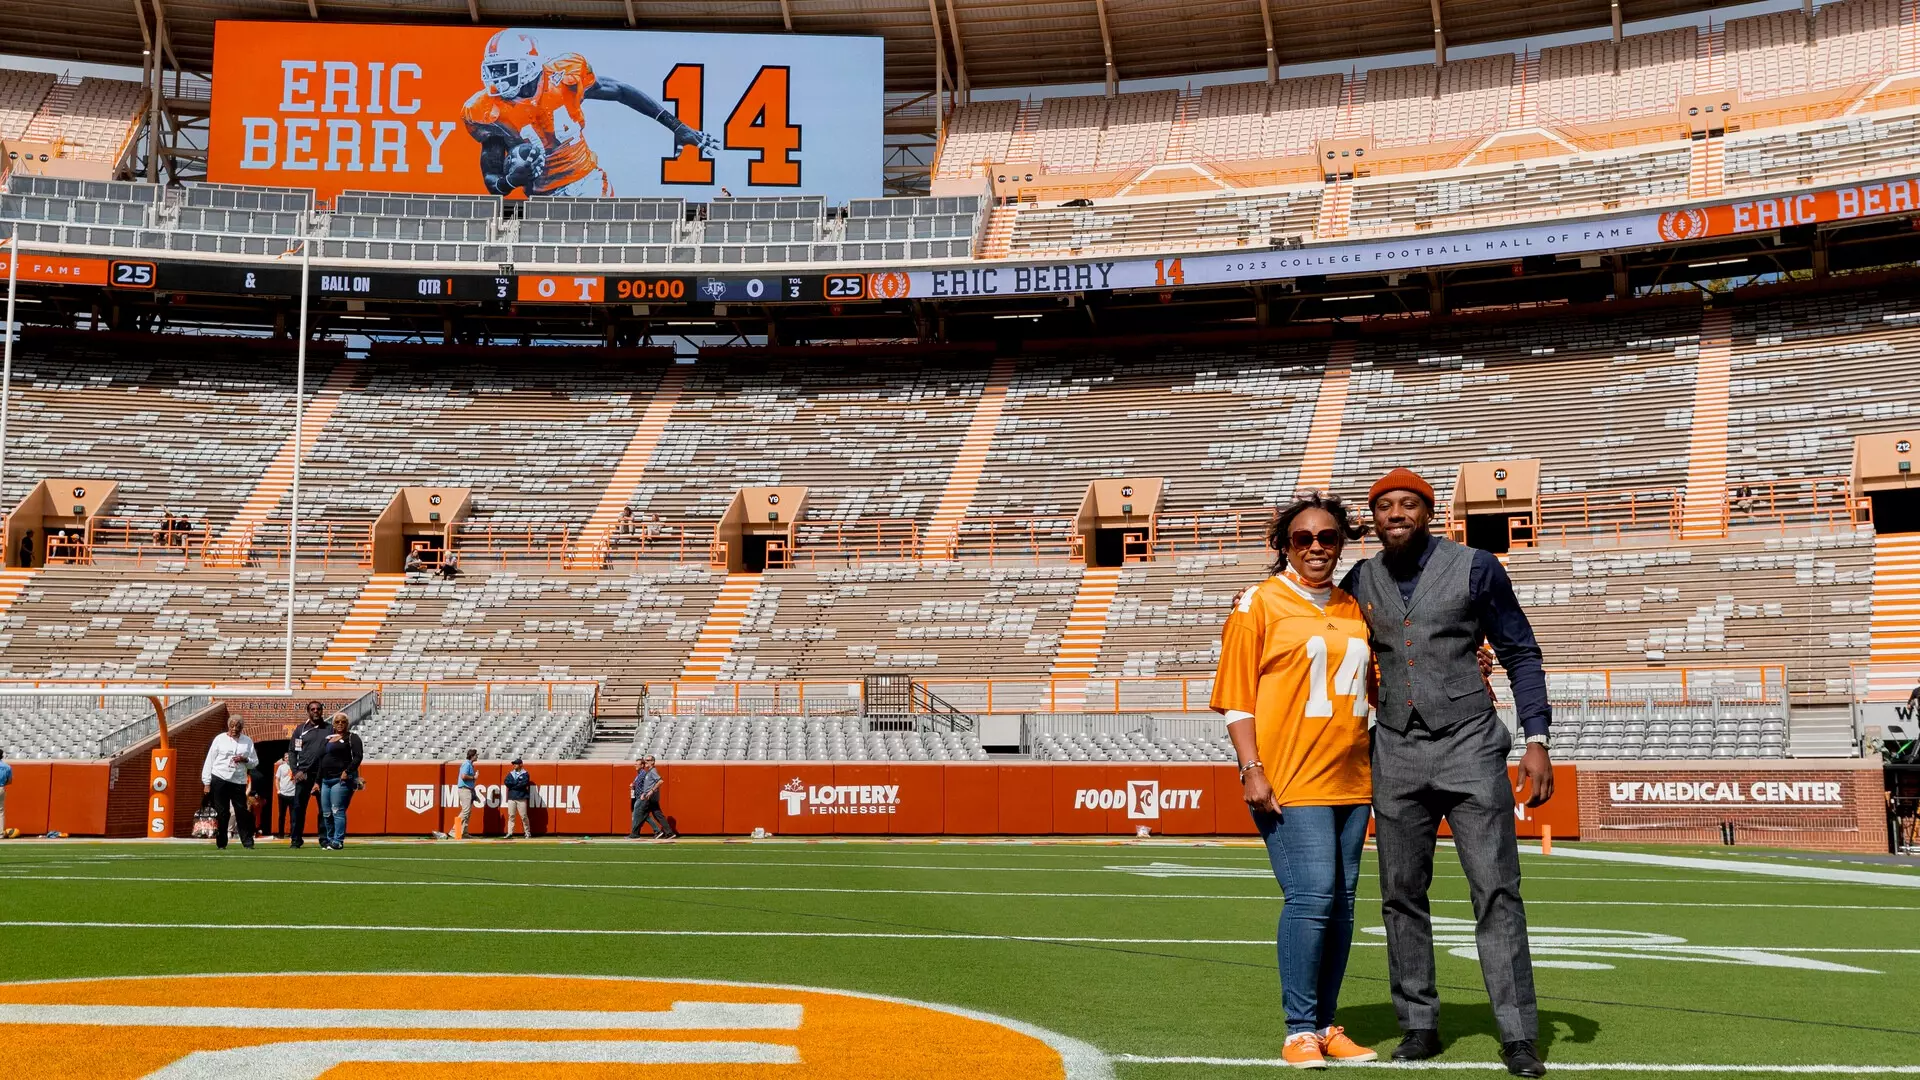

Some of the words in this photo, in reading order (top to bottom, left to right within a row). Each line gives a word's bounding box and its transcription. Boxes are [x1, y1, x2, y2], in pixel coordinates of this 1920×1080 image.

[279, 60, 423, 114] ERIC
[660, 63, 802, 187] 14
[239, 117, 456, 173] BERRY
[1731, 194, 1817, 233] ERIC
[1836, 178, 1920, 219] BER
[1226, 261, 1267, 272] 2023
[1280, 254, 1362, 268] COLLEGE
[1375, 243, 1472, 261] FOOTBALL
[1486, 238, 1532, 250] HALL
[1547, 234, 1569, 244] OF
[1584, 227, 1633, 240] FAME
[34, 264, 81, 275] FAME
[117, 265, 150, 283] 25
[931, 268, 998, 296] ERIC
[1014, 262, 1114, 293] BERRY
[1155, 258, 1184, 286] 14
[244, 272, 256, 289] &
[321, 275, 350, 292] BALL
[353, 276, 370, 292] ON
[418, 279, 441, 295] QTR
[447, 278, 453, 295] 1
[574, 277, 598, 301] T
[617, 279, 685, 299] 90:00
[830, 278, 860, 296] 25
[497, 286, 507, 298] 3
[790, 286, 800, 298] 3
[74, 489, 85, 497] Y7
[1305, 635, 1370, 718] 14
[151, 756, 168, 833] VOLS
[529, 785, 581, 809] MILK
[1074, 789, 1127, 809] FOOD
[1751, 782, 1841, 801] CENTER
[810, 805, 896, 815] TENNESSEE
